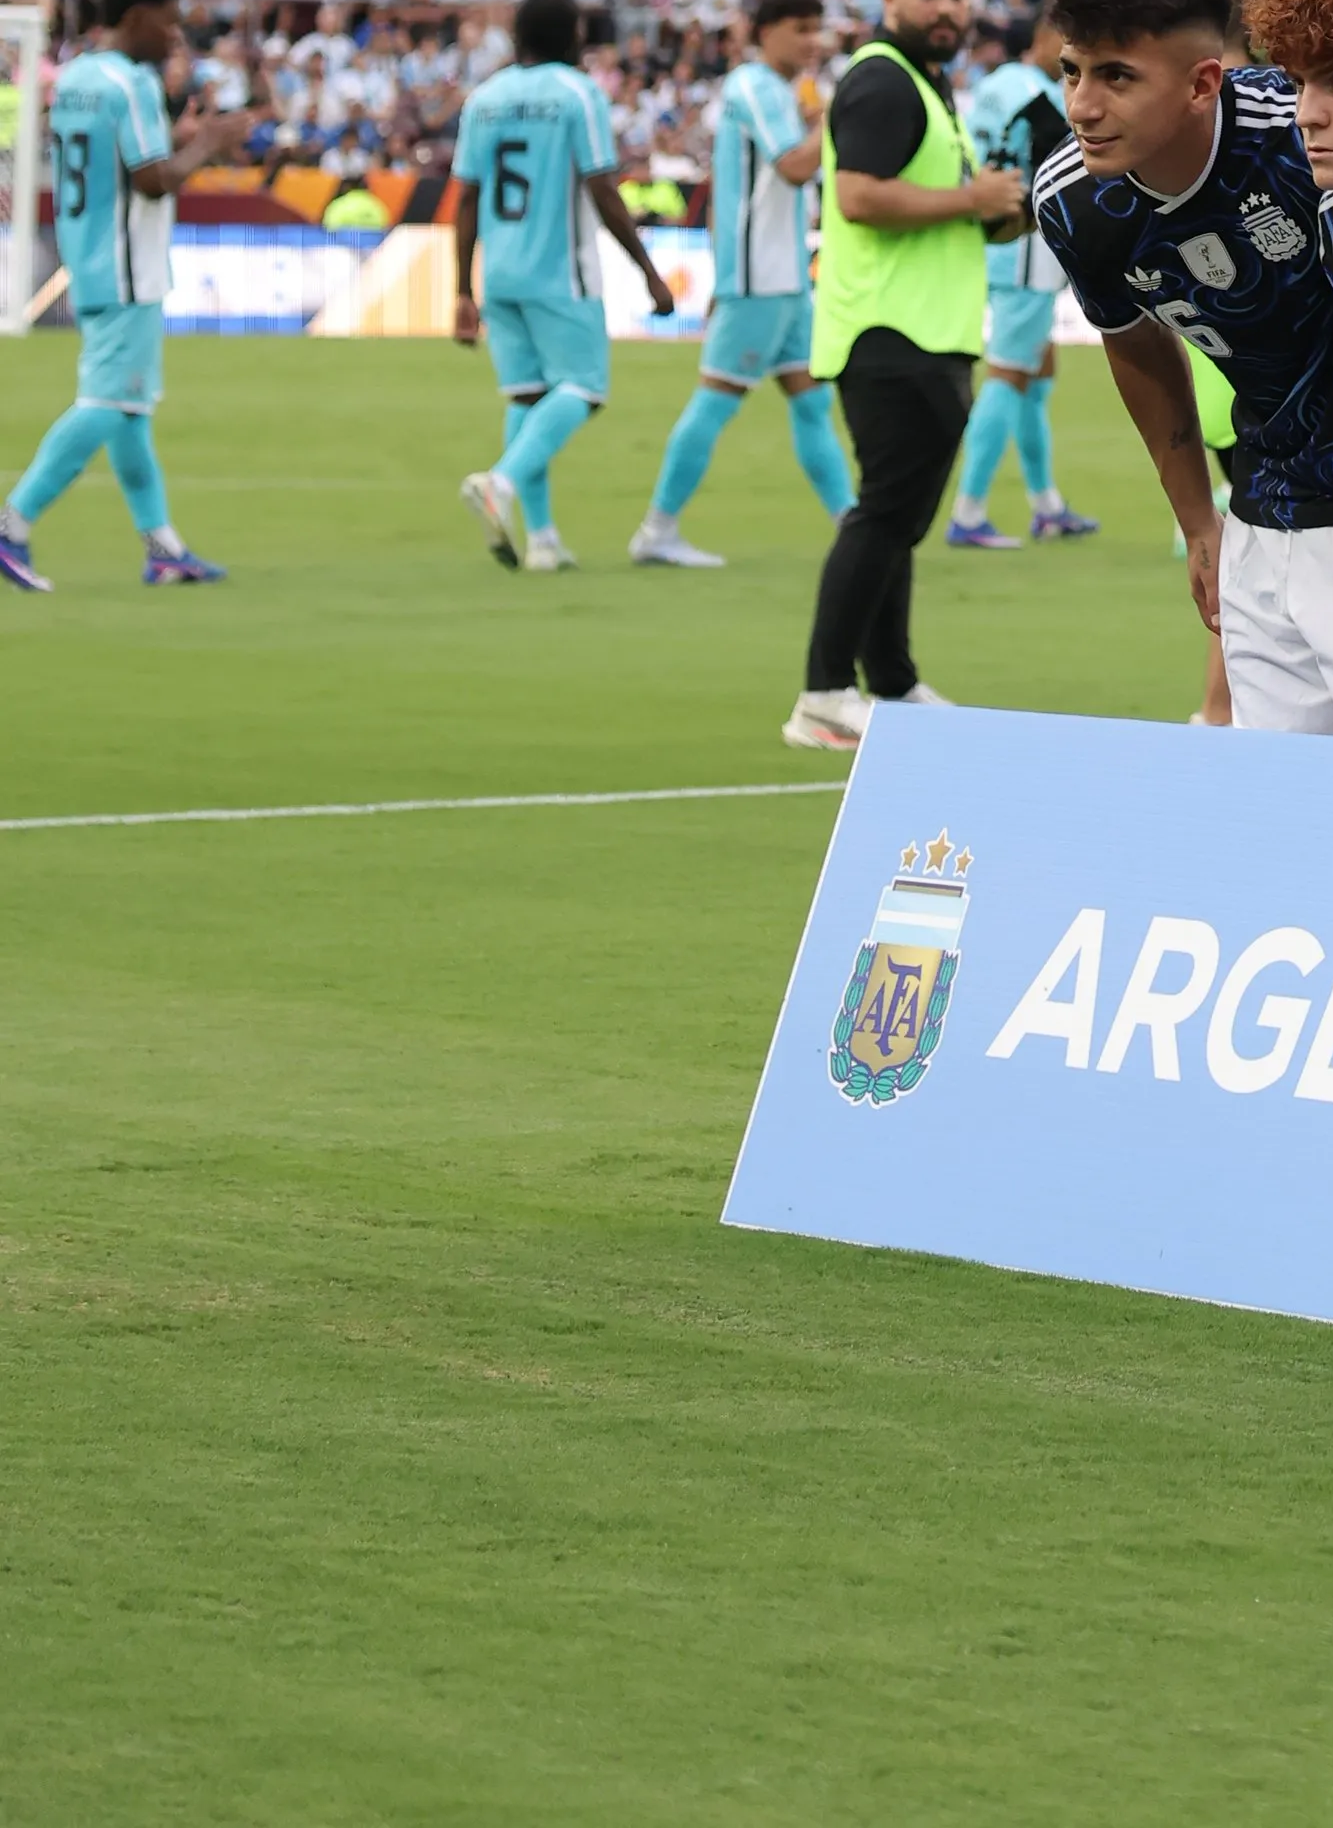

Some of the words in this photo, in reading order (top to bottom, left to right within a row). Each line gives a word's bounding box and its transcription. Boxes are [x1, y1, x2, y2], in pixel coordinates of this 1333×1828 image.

[494, 141, 530, 221] 6
[1263, 223, 1292, 247] AFA
[1206, 268, 1226, 278] FIFA
[856, 954, 922, 1057] AFA
